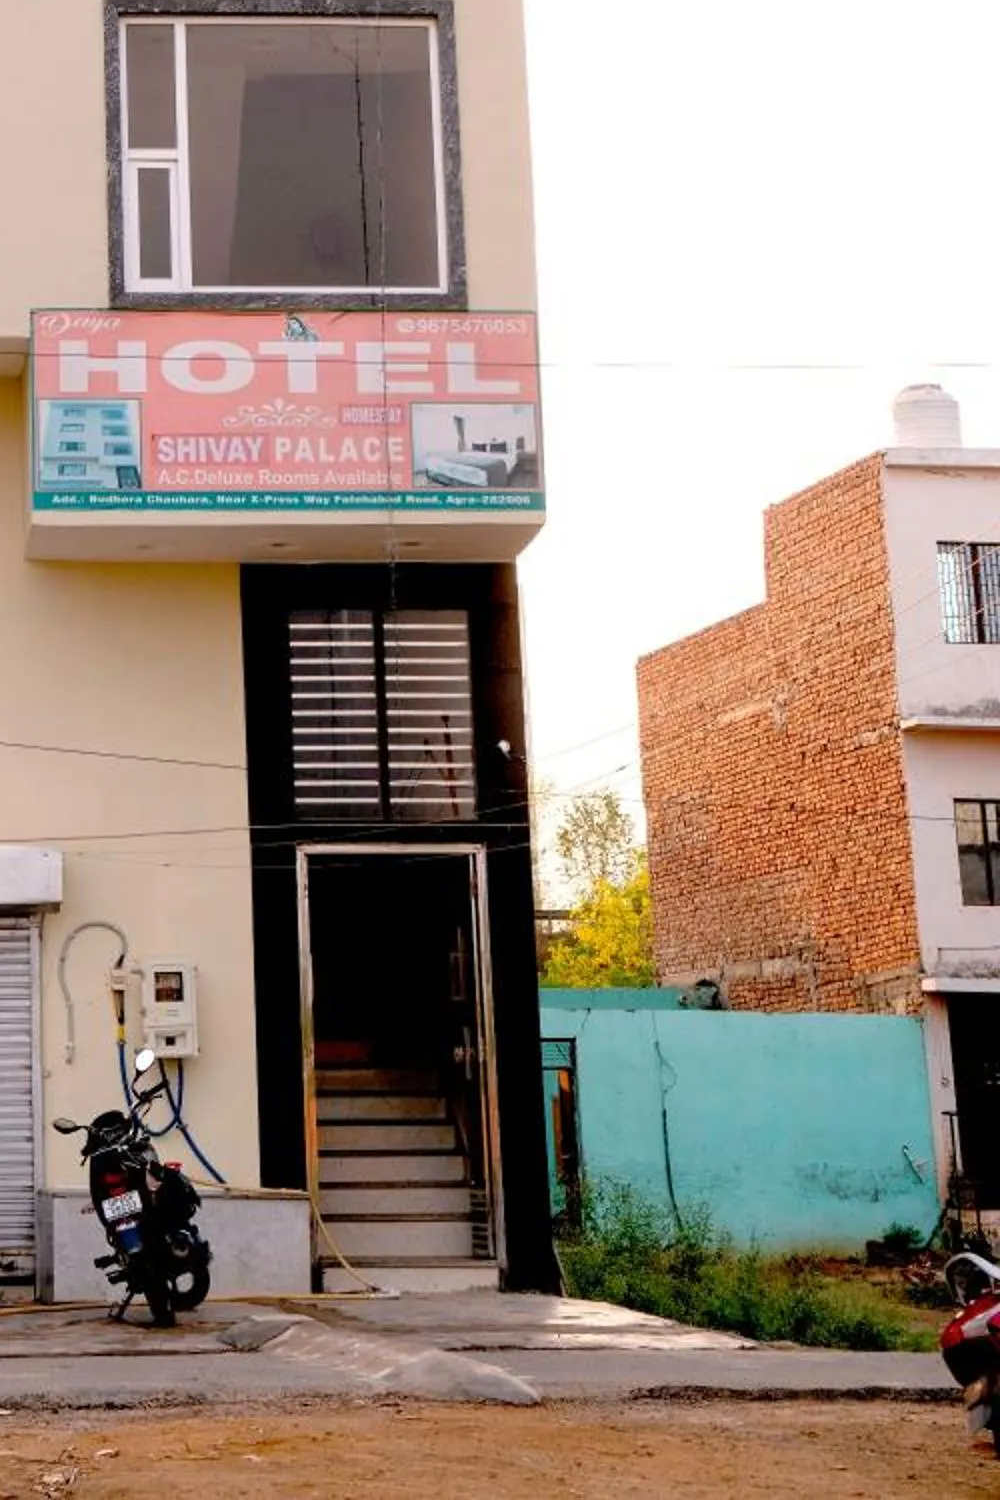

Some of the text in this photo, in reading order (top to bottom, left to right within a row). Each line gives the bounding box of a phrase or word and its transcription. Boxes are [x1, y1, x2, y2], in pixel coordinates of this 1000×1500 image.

[59, 340, 521, 394] HOTEL
[157, 436, 404, 463] SHIVAY PALACE
[258, 470, 320, 485] Rooms
